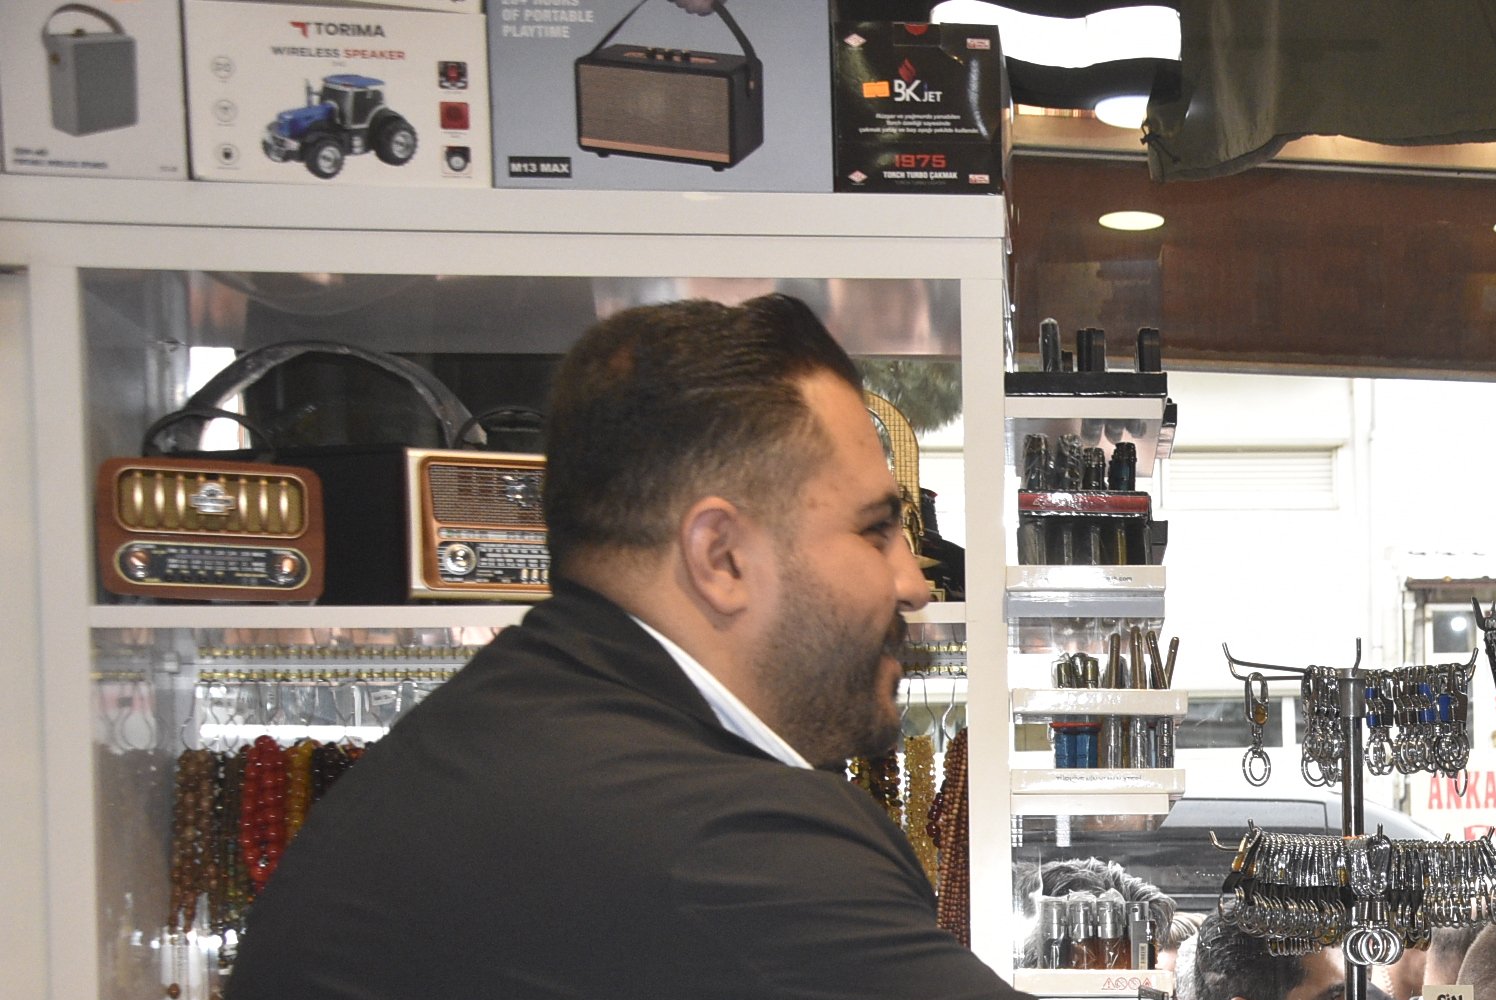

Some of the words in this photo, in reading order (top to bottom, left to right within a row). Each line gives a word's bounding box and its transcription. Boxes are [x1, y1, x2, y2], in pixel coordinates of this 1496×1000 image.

[501, 8, 521, 21] OF
[523, 9, 594, 23] PORTABLE
[501, 24, 571, 39] PLAYTIME
[270, 45, 341, 59] WIRELESS
[343, 48, 406, 61] SPEAKER
[894, 153, 947, 168] 1975
[510, 163, 538, 173] M13
[540, 163, 570, 174] MAX
[882, 170, 906, 179] TORCH
[906, 170, 928, 179] TURBO
[929, 170, 958, 181] ÇAKMAK
